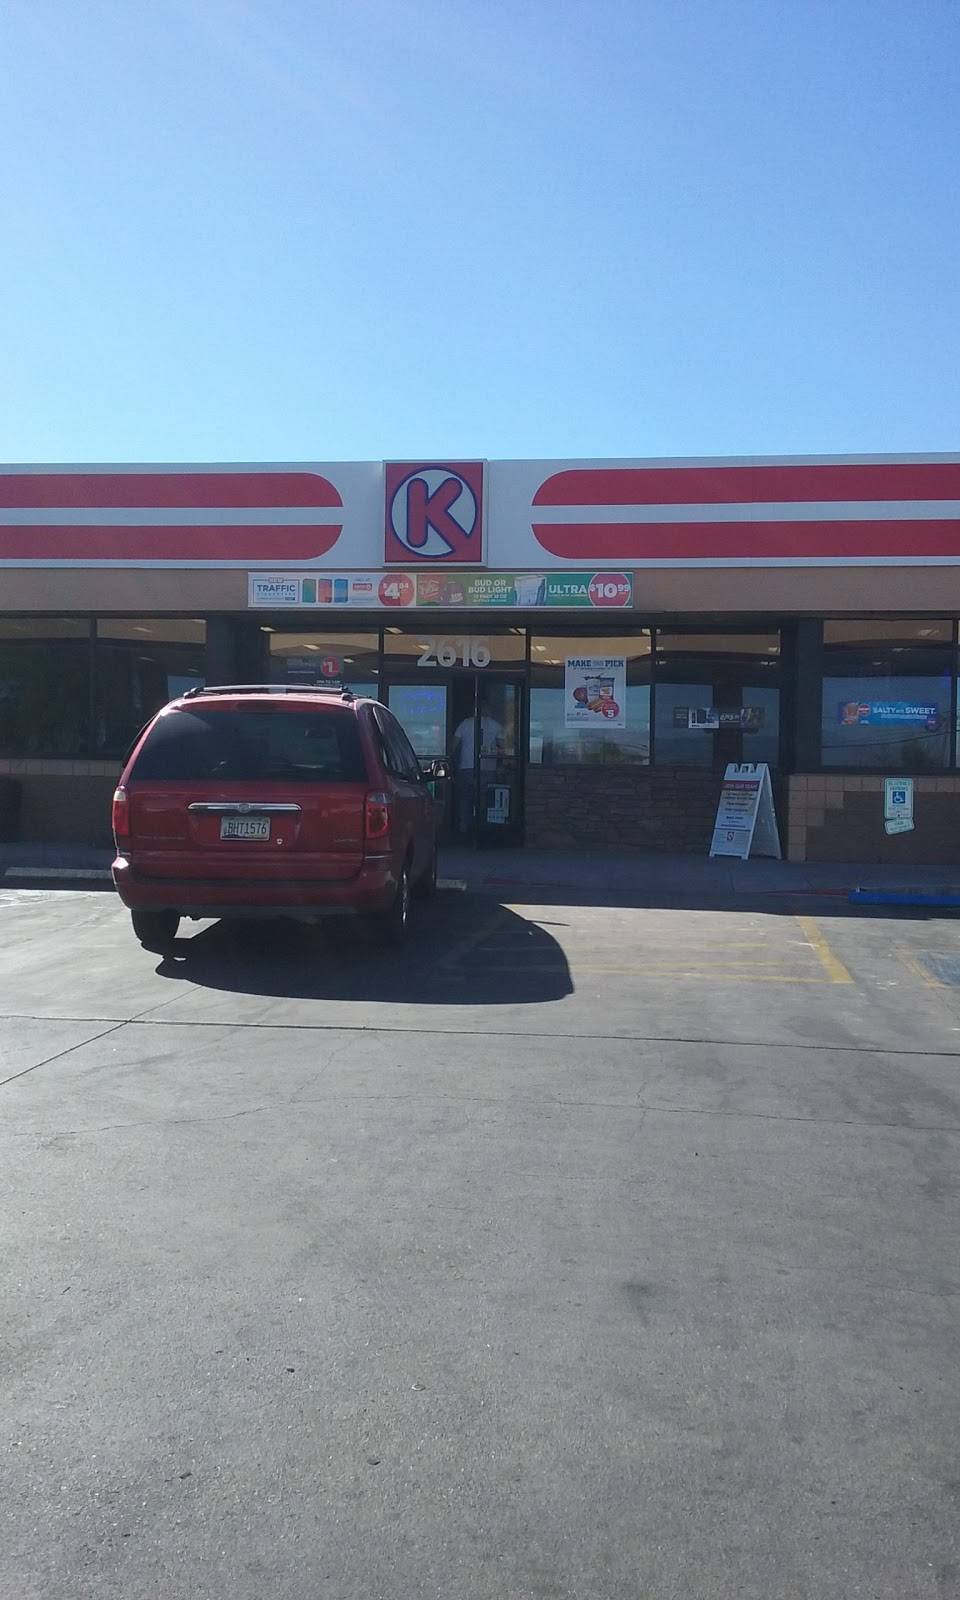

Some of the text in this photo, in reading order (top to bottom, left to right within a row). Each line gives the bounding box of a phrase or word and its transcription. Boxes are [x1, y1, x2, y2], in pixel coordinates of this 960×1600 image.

[403, 474, 472, 556] K
[549, 585, 588, 594] ULTRA
[417, 640, 491, 668] 2616
